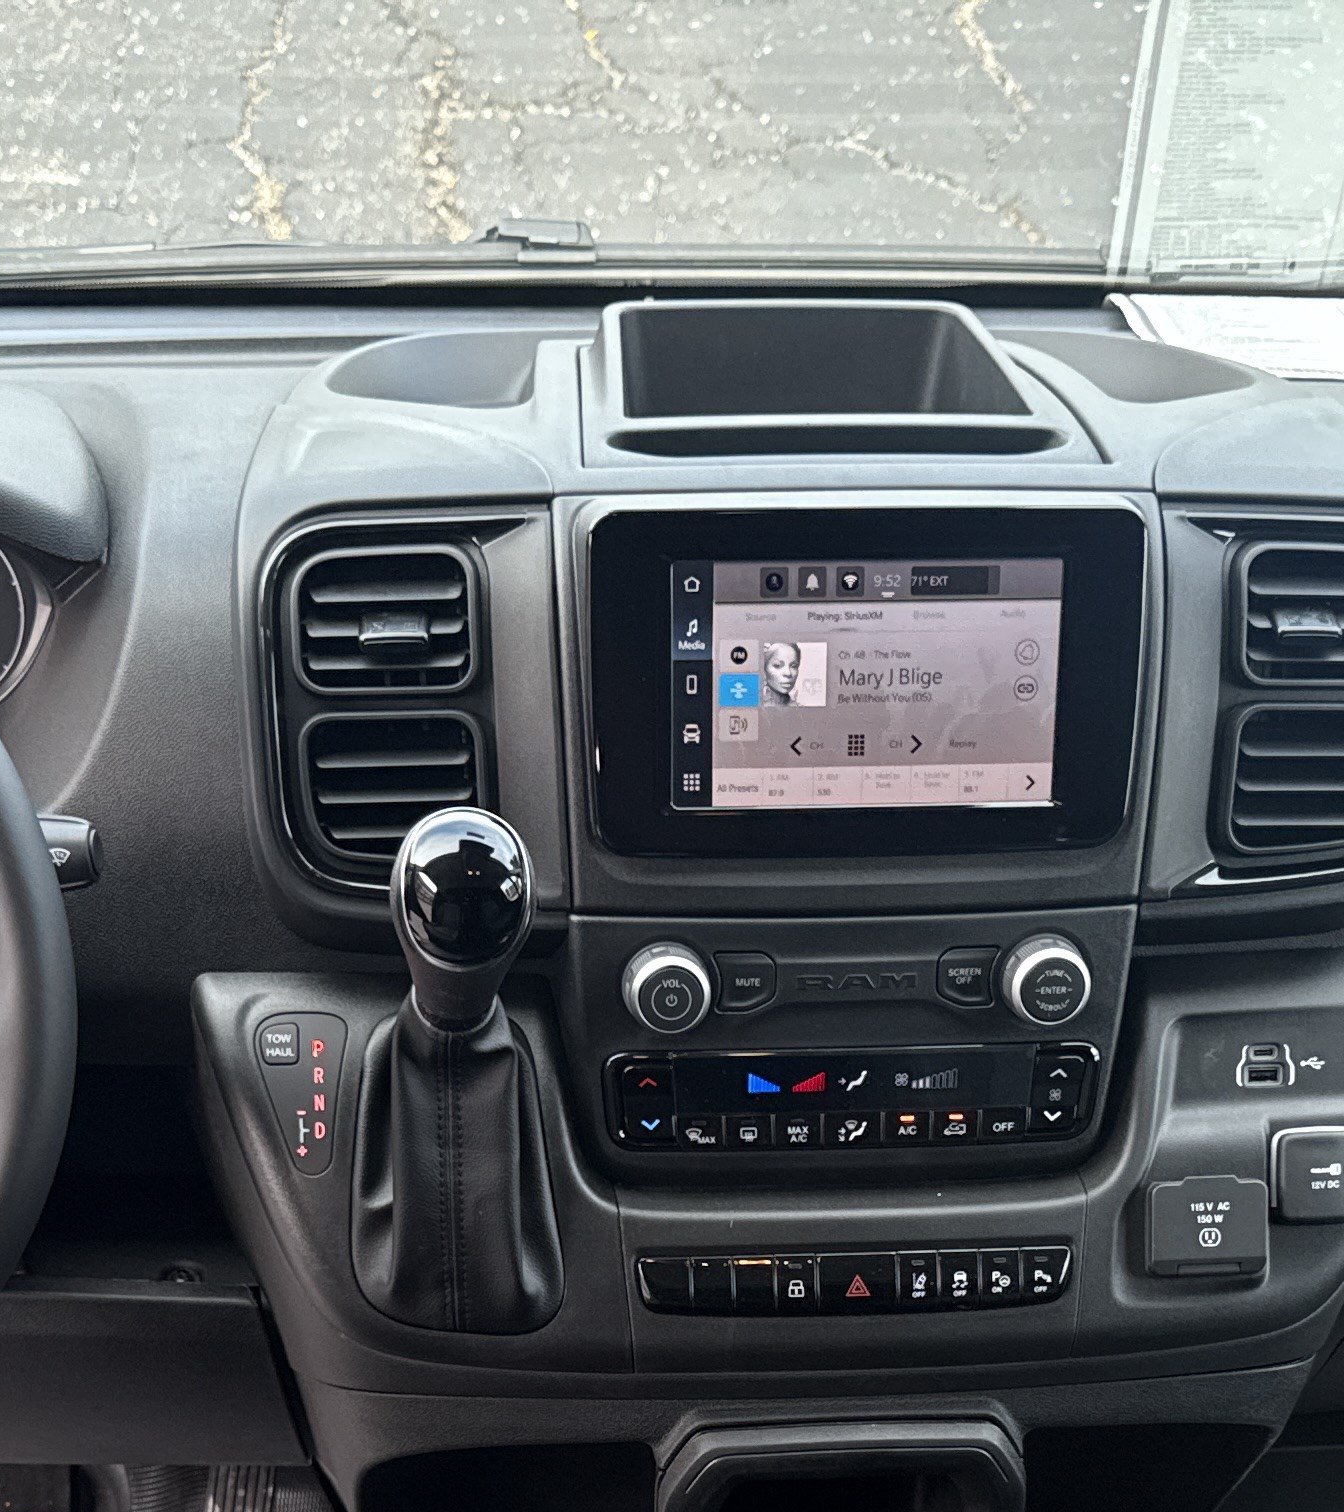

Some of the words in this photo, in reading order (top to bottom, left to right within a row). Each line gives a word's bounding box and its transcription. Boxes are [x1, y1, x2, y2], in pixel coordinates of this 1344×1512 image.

[873, 574, 901, 588] 9:52
[930, 576, 949, 587] EXT
[807, 611, 841, 623] Playing:
[844, 611, 883, 621] SiriusXM
[677, 640, 706, 651] Media
[839, 668, 884, 690] Mary
[887, 667, 894, 687] J
[899, 667, 943, 690] Blige
[851, 693, 890, 703] Without
[890, 692, 910, 703] You
[729, 783, 759, 793] Presets
[948, 967, 982, 978] SCREEN
[661, 978, 682, 989] VOL
[735, 977, 761, 988] MUTE
[795, 972, 918, 991] RAM
[955, 976, 973, 985] OFF
[1040, 986, 1068, 995] ENTER
[265, 1033, 292, 1044] TOW
[265, 1046, 296, 1058] HAUL
[311, 1040, 324, 1058] P
[313, 1067, 325, 1085] R
[313, 1094, 326, 1112] N
[314, 1121, 326, 1140] D
[787, 1125, 810, 1135] MAX
[897, 1125, 918, 1136] A/C
[992, 1121, 1016, 1133] OFF
[697, 1136, 717, 1145] MAX
[789, 1134, 808, 1144] A/C
[1310, 1180, 1326, 1190] 12V
[1326, 1180, 1341, 1190] DC
[1190, 1202, 1205, 1212] 115
[1205, 1202, 1214, 1211] V
[1216, 1202, 1231, 1211] AC
[1196, 1214, 1213, 1224] 150
[1213, 1214, 1224, 1223] W
[911, 1290, 927, 1299] OFF
[952, 1289, 968, 1298] OFF
[991, 1285, 1003, 1294] ON
[1033, 1285, 1048, 1294] OFF
